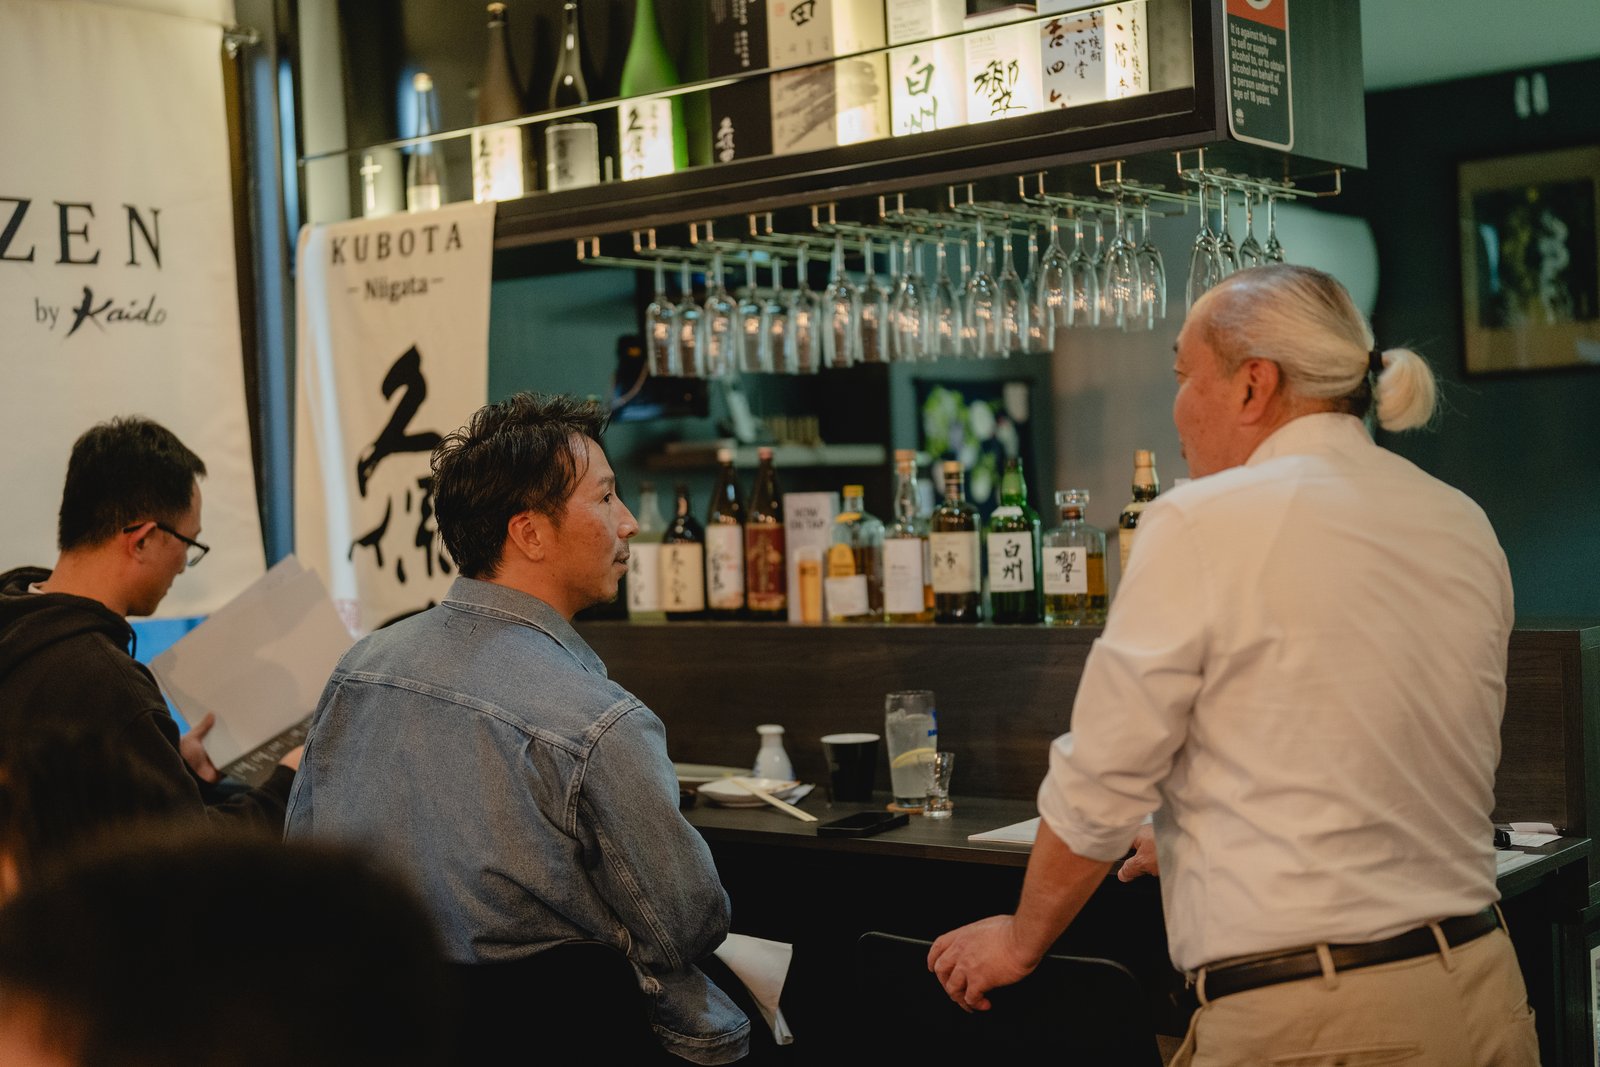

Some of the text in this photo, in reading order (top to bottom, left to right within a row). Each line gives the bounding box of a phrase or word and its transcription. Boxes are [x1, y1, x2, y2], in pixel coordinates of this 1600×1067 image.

[1259, 31, 1267, 44] the
[1267, 34, 1277, 46] law
[1231, 49, 1250, 64] alcohol
[1238, 39, 1246, 50] sell
[1253, 44, 1269, 59] supply
[1232, 62, 1251, 77] alcohol
[1233, 89, 1243, 101] age
[1237, 77, 1255, 90] person
[1255, 81, 1270, 94] under
[1270, 84, 1279, 97] the
[0, 196, 163, 271] ZEN
[331, 221, 464, 265] KUBOTA
[34, 285, 168, 338] by Kaido
[1003, 538, 1024, 583] 白州
